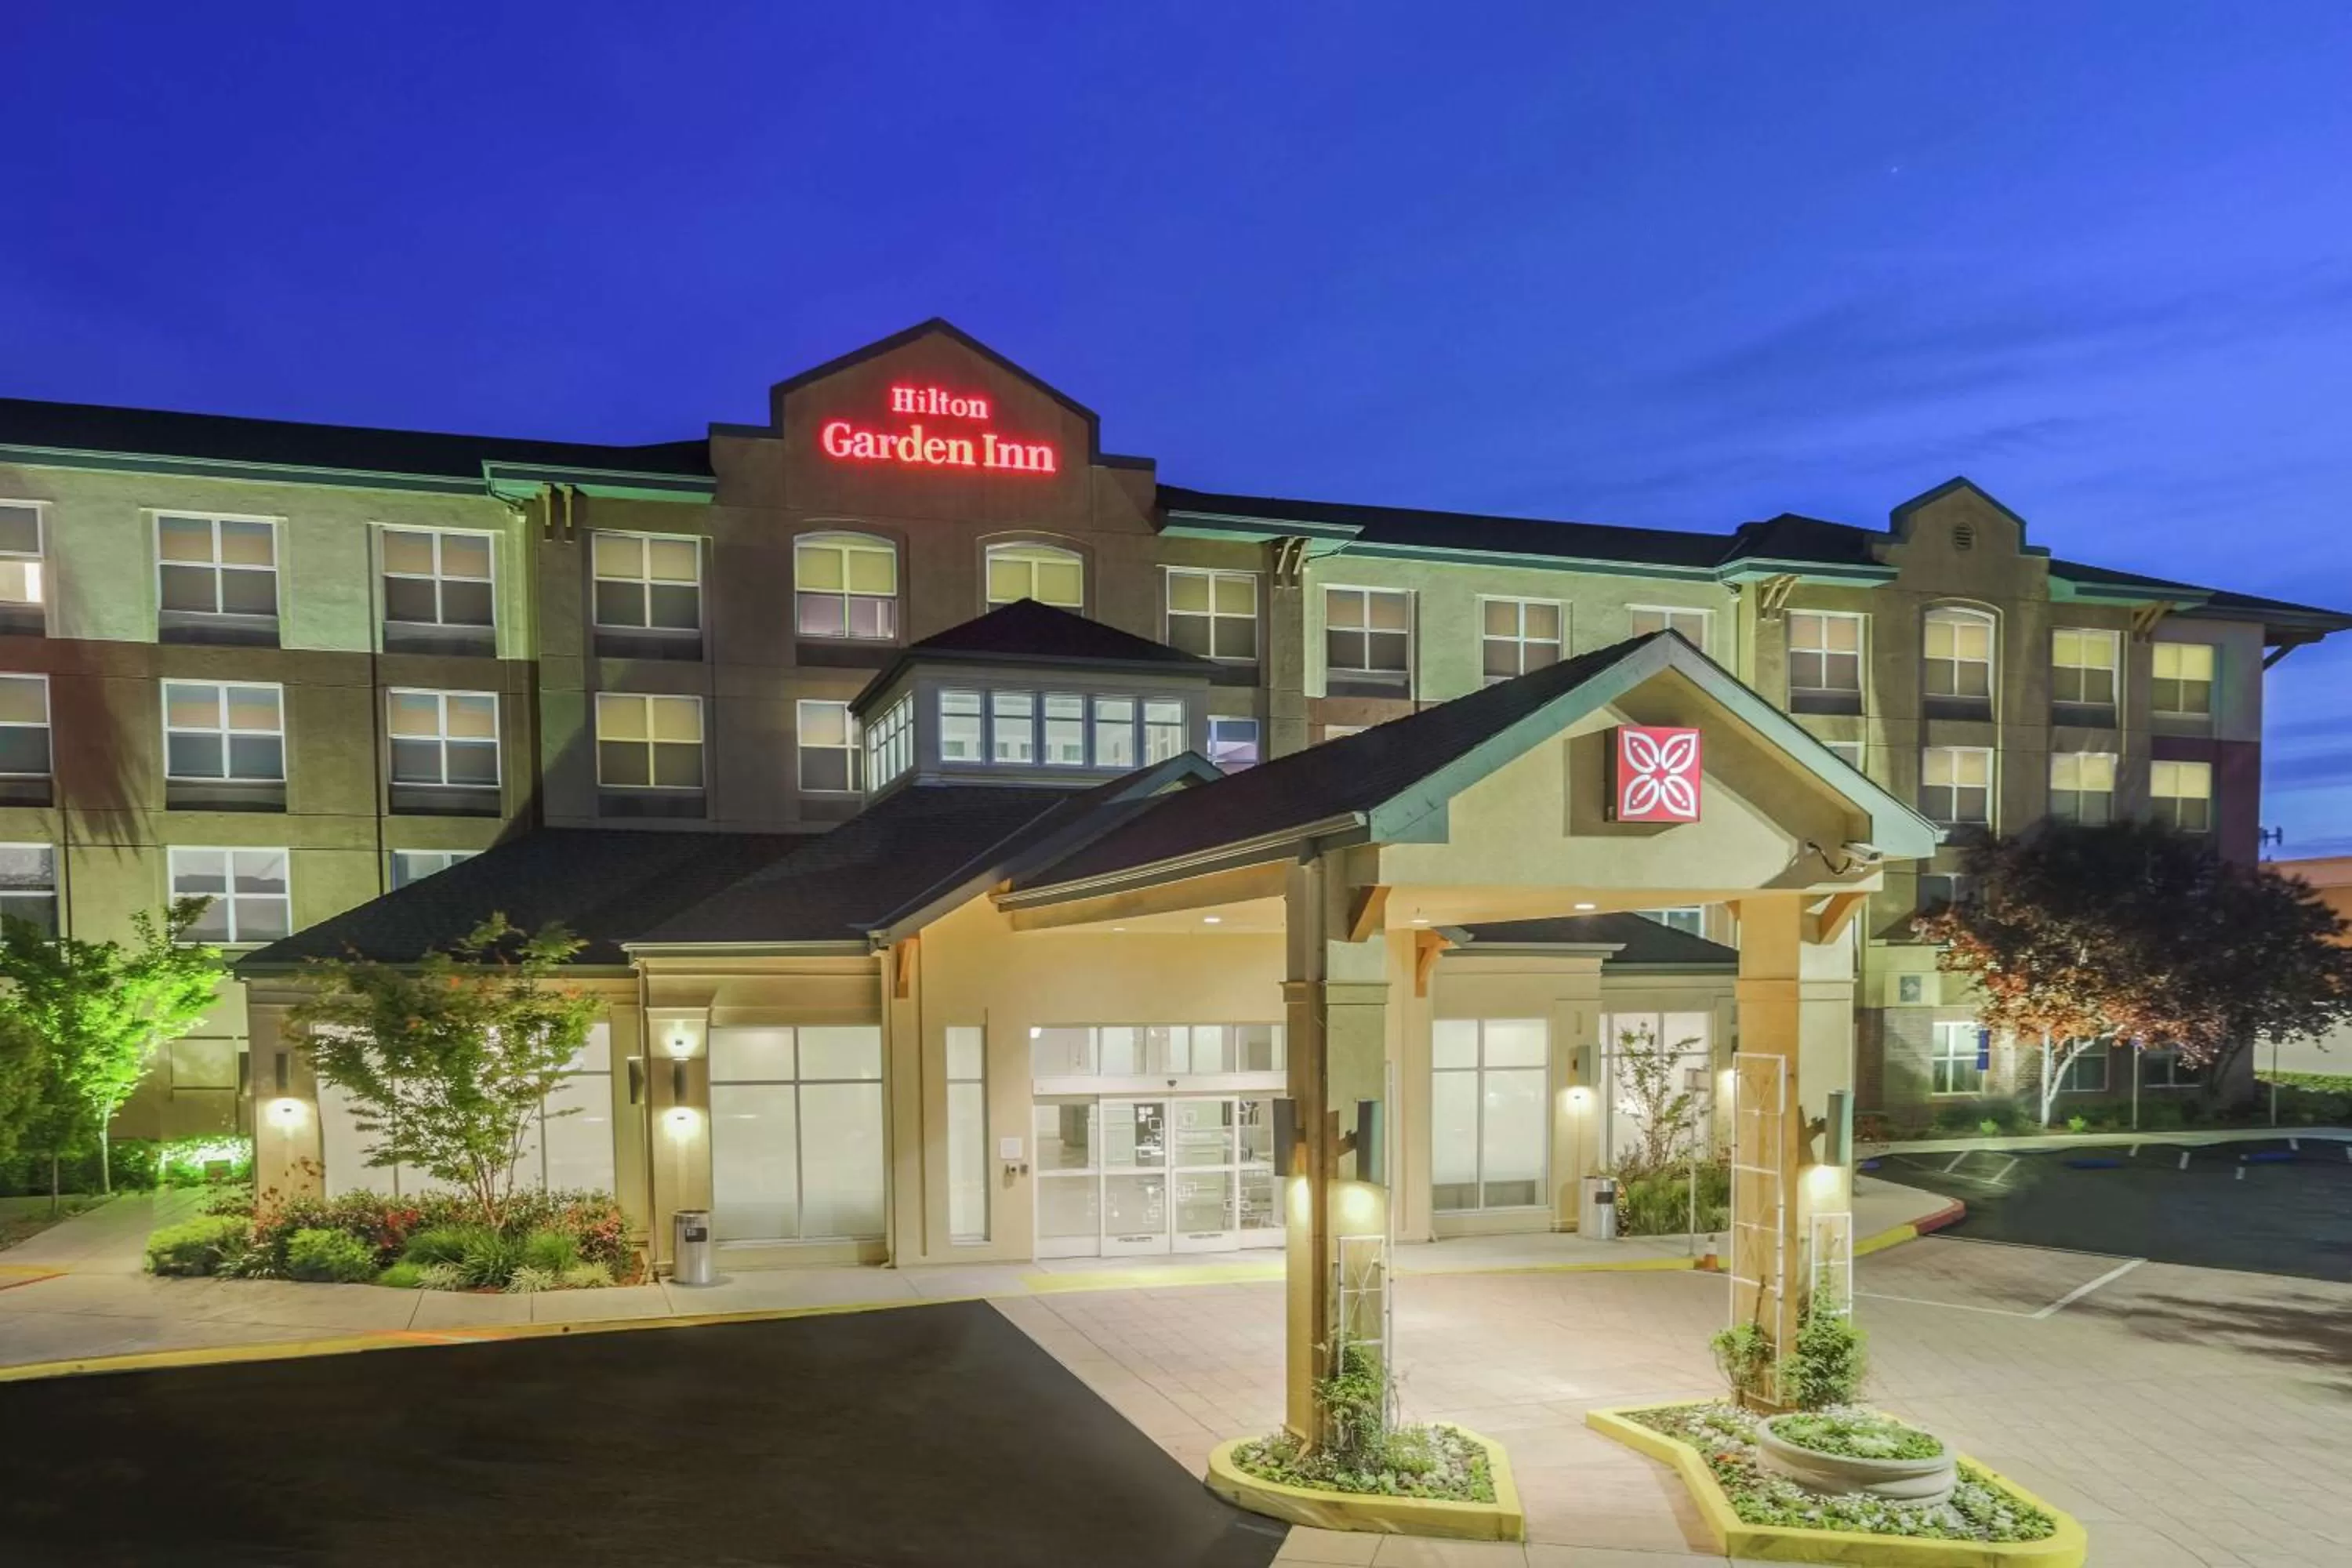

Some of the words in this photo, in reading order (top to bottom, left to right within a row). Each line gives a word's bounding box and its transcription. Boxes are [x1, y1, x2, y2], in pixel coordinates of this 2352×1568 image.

[891, 387, 989, 419] Hilton
[823, 422, 976, 466] Garden
[982, 434, 1056, 472] Inn
